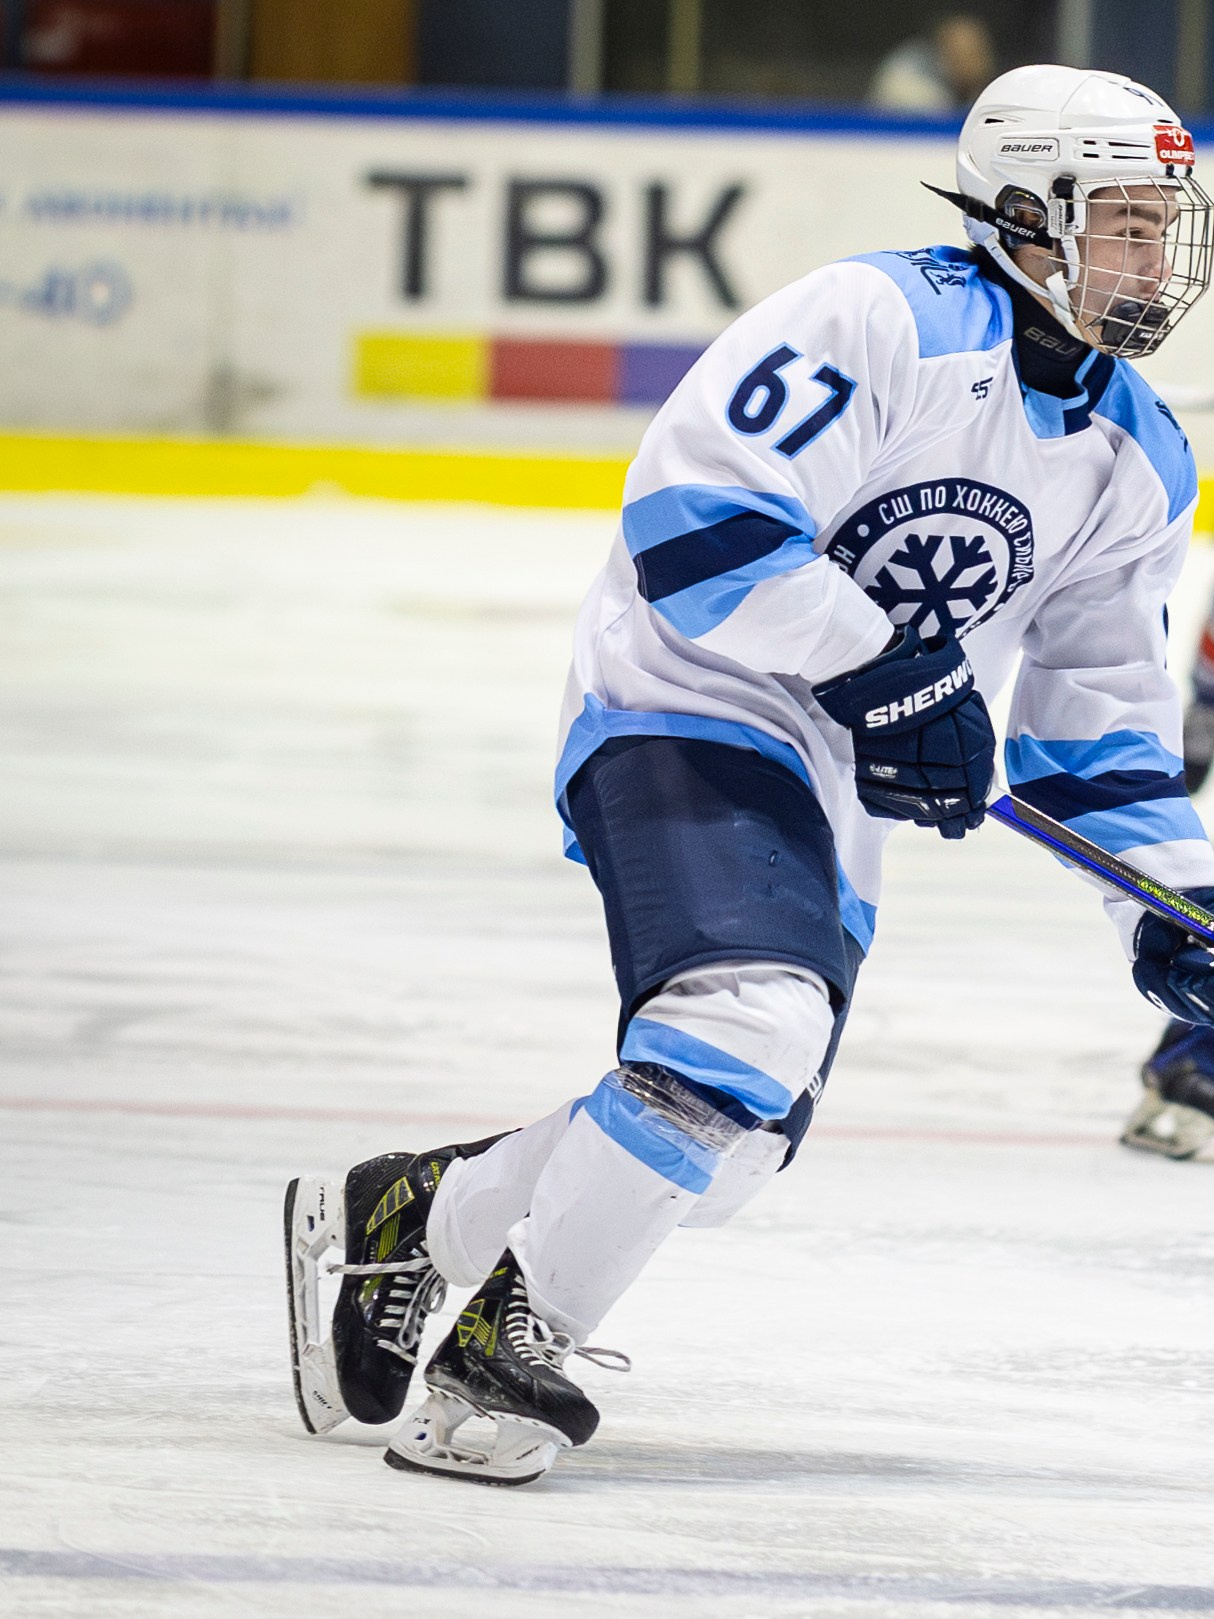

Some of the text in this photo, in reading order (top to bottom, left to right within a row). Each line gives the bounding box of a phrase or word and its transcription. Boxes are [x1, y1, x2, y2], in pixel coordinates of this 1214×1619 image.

[725, 341, 859, 461] 67
[879, 494, 914, 525] СШ
[919, 486, 946, 511] ПО
[952, 484, 1028, 534] ХОККЕЮ
